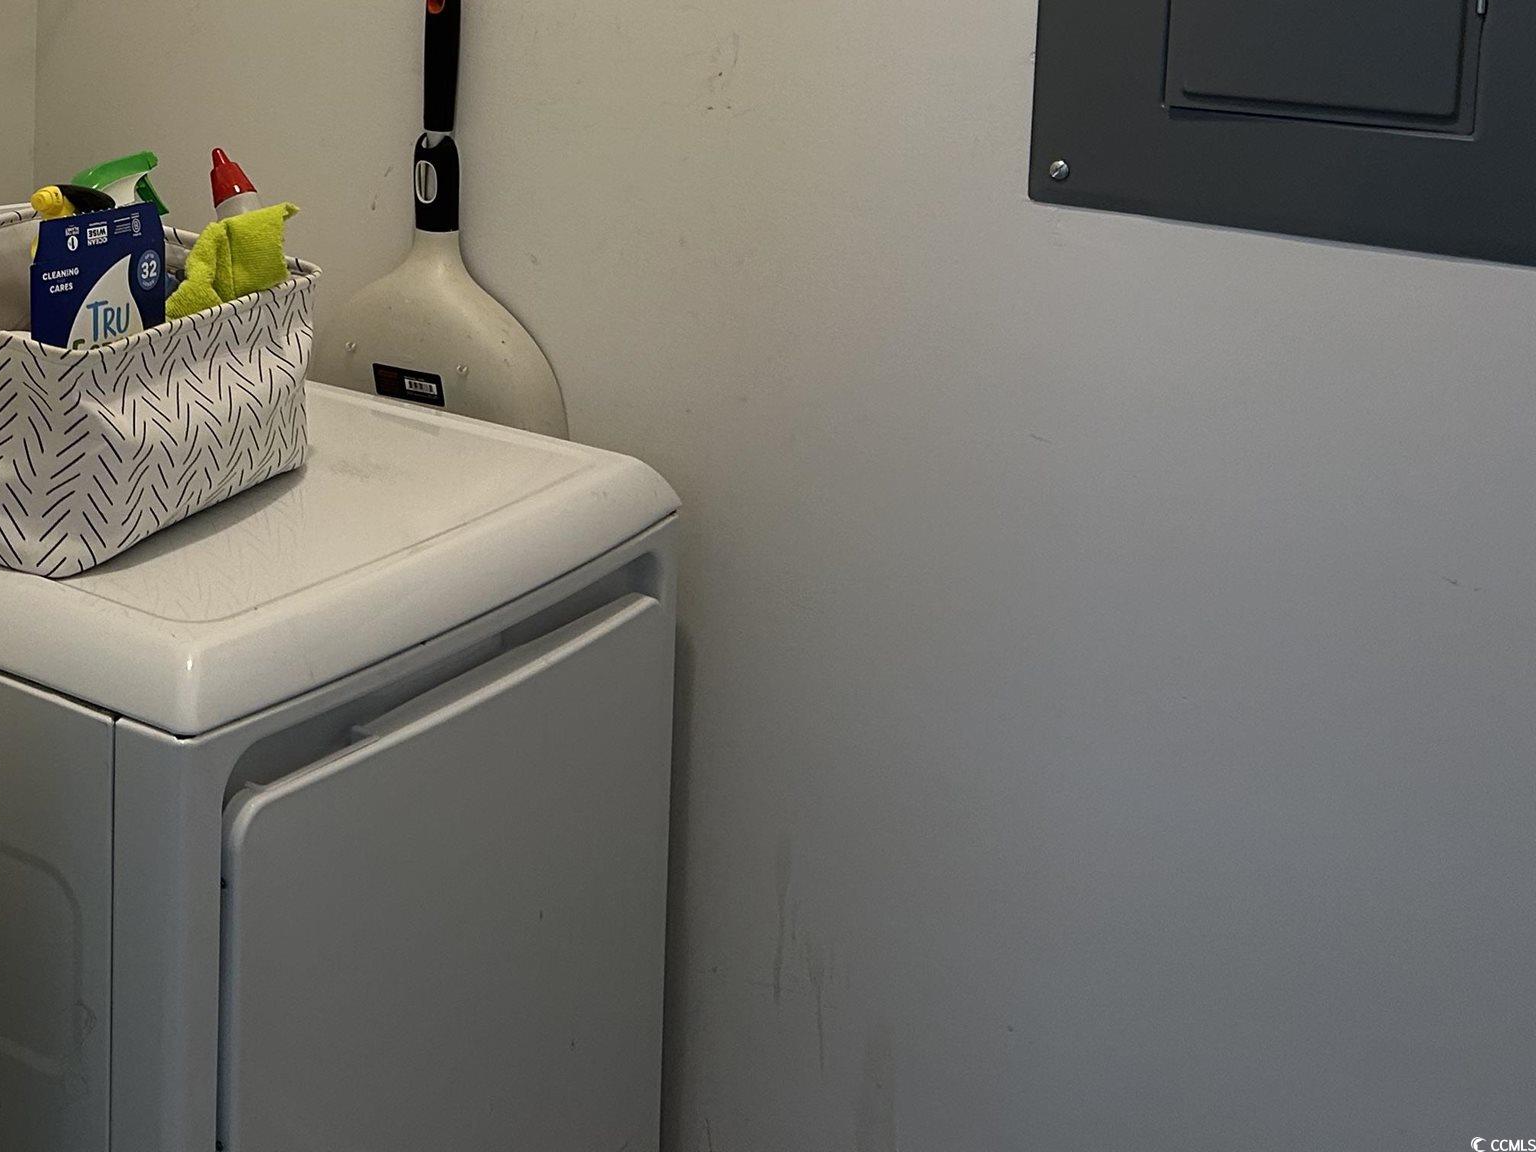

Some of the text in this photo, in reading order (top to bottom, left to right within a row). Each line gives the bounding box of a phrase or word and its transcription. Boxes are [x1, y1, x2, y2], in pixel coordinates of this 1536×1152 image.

[88, 229, 107, 238] WISE
[87, 237, 108, 246] OCEAN
[42, 268, 80, 281] CLEANING
[141, 260, 157, 279] 32
[49, 282, 73, 294] CARES
[86, 300, 130, 342] TRU
